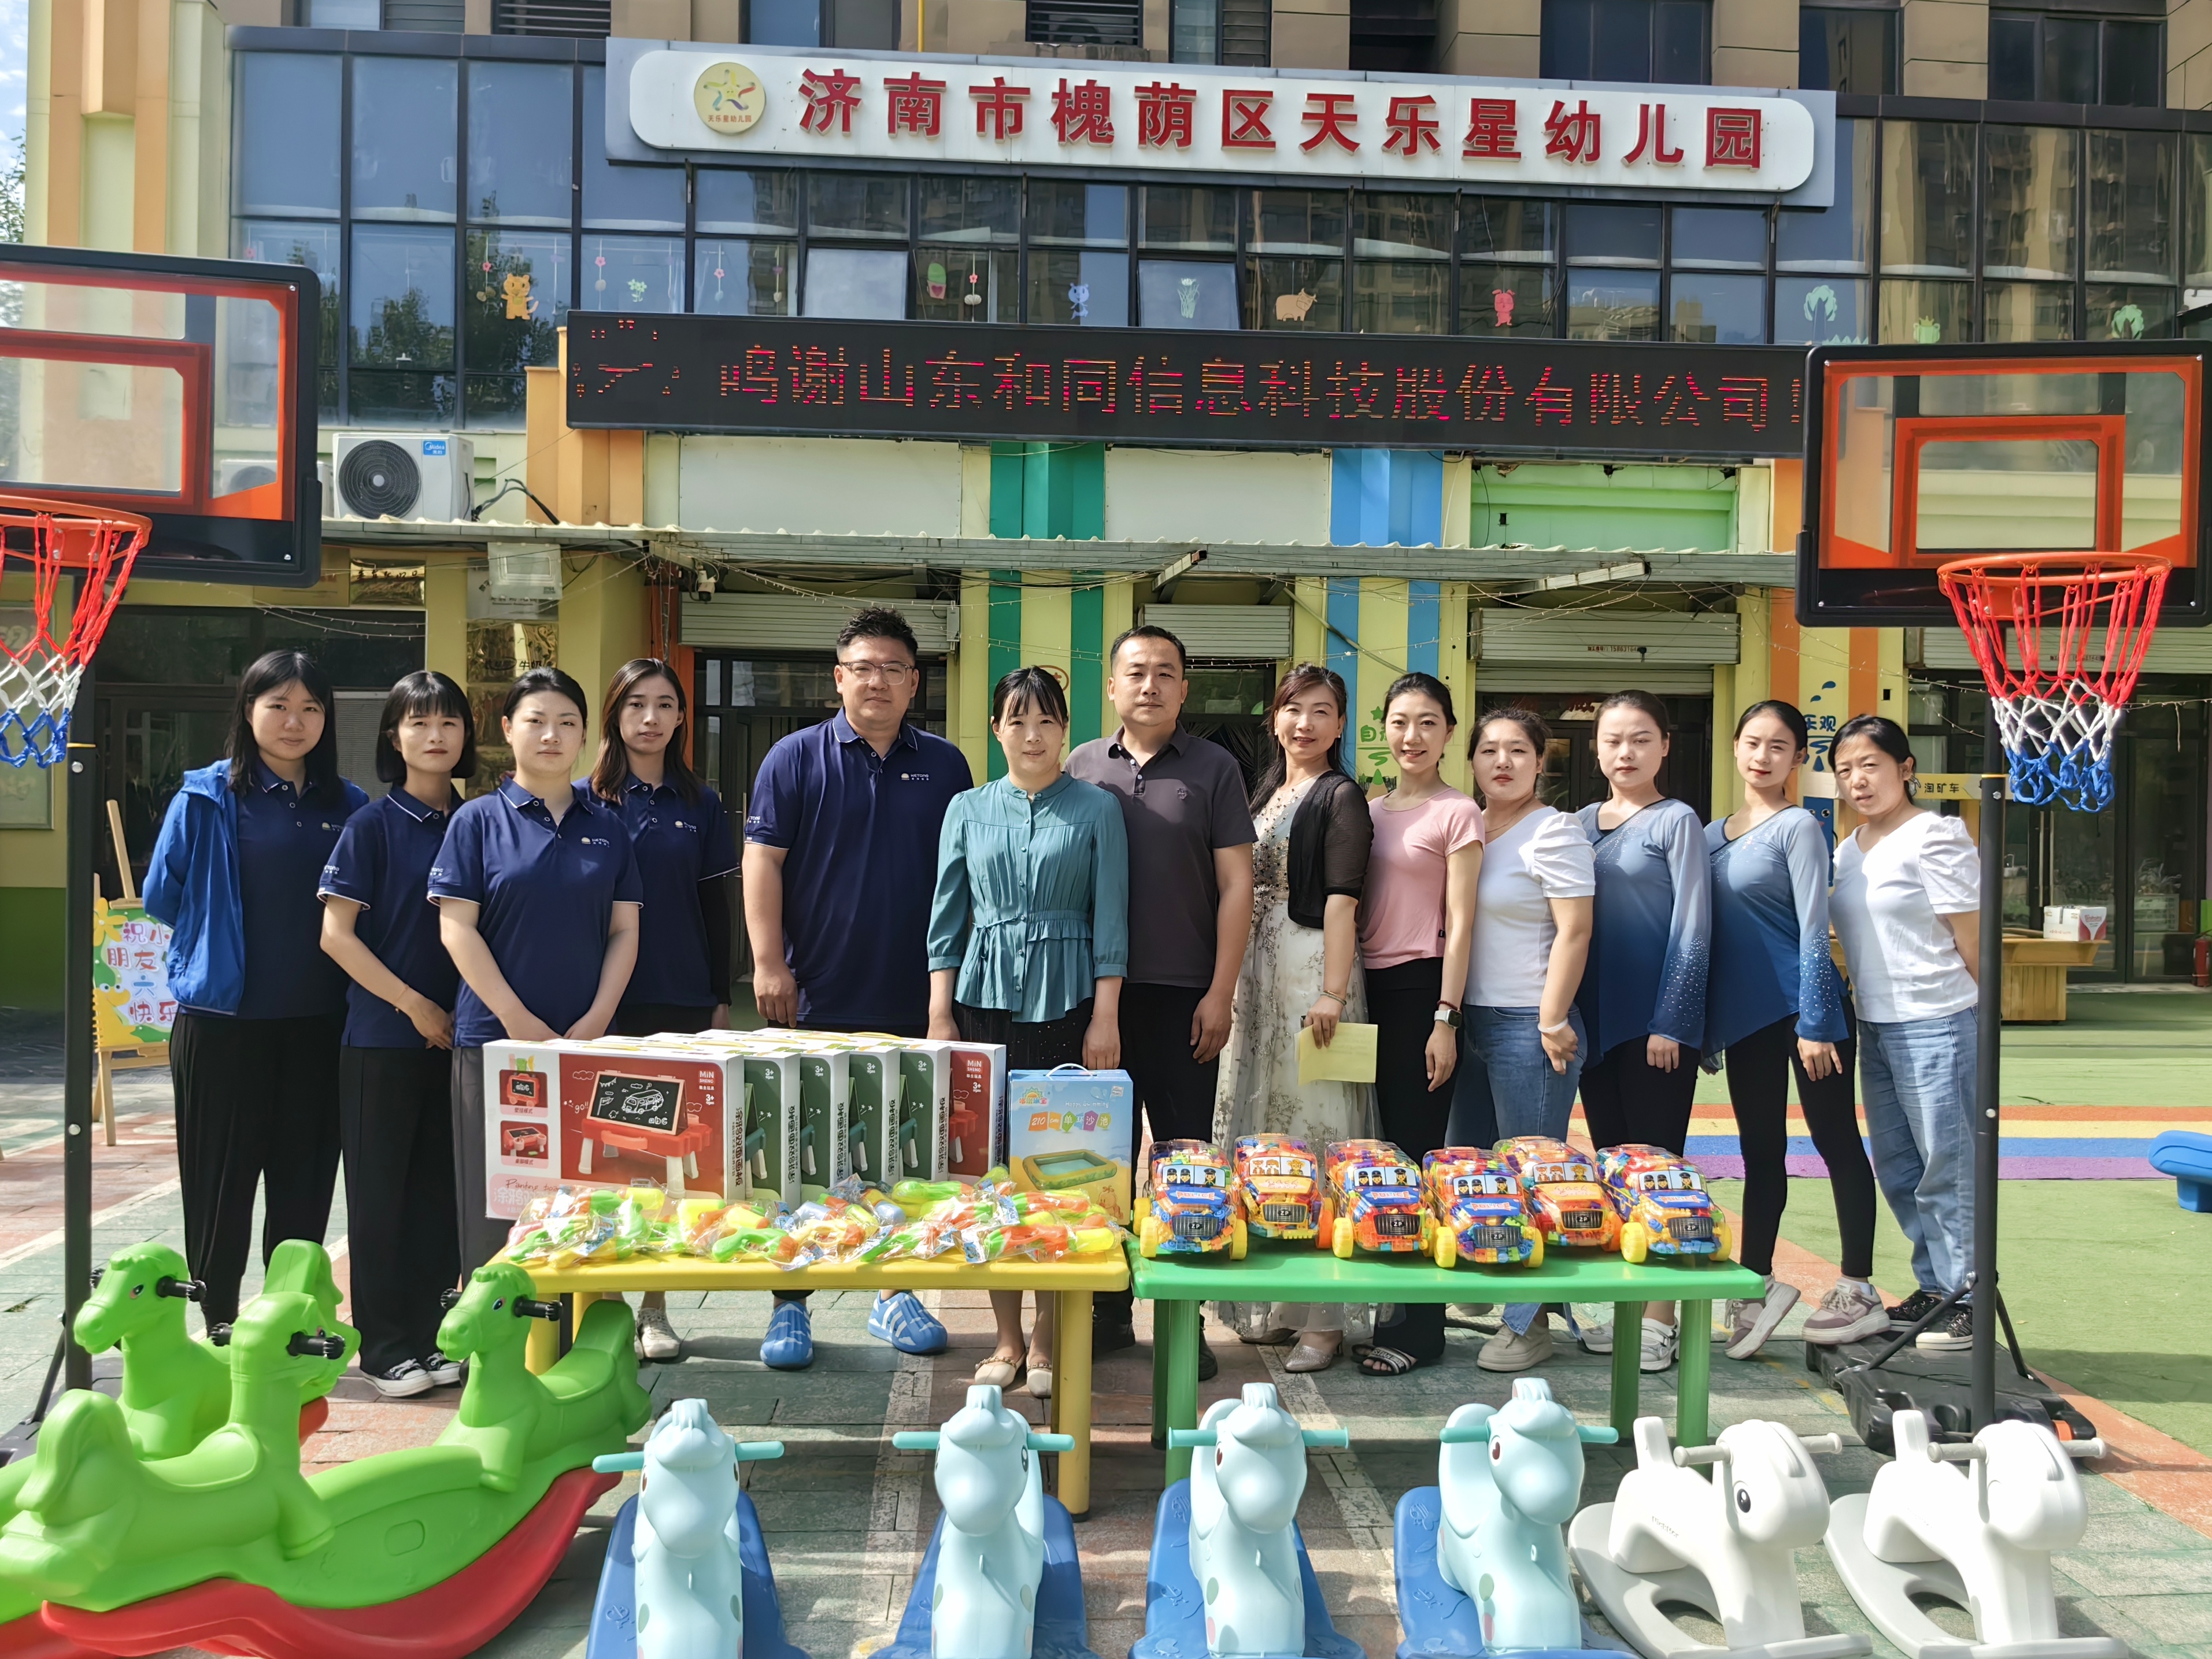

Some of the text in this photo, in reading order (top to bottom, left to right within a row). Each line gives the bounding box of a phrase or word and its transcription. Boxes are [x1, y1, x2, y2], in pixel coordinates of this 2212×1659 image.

[708, 114, 752, 123] 天乐星幼儿园
[798, 68, 1762, 172] 济南市槐荫区天乐星幼儿园
[1924, 783, 1959, 794] 淘矿车
[123, 922, 171, 945] 祝小
[107, 947, 167, 971] 朋友
[130, 1001, 178, 1023] 快乐
[918, 1060, 927, 1068] 3+
[649, 1116, 668, 1125] abc
[1031, 1117, 1046, 1126] 210
[1064, 1116, 1109, 1126] 单环沙池
